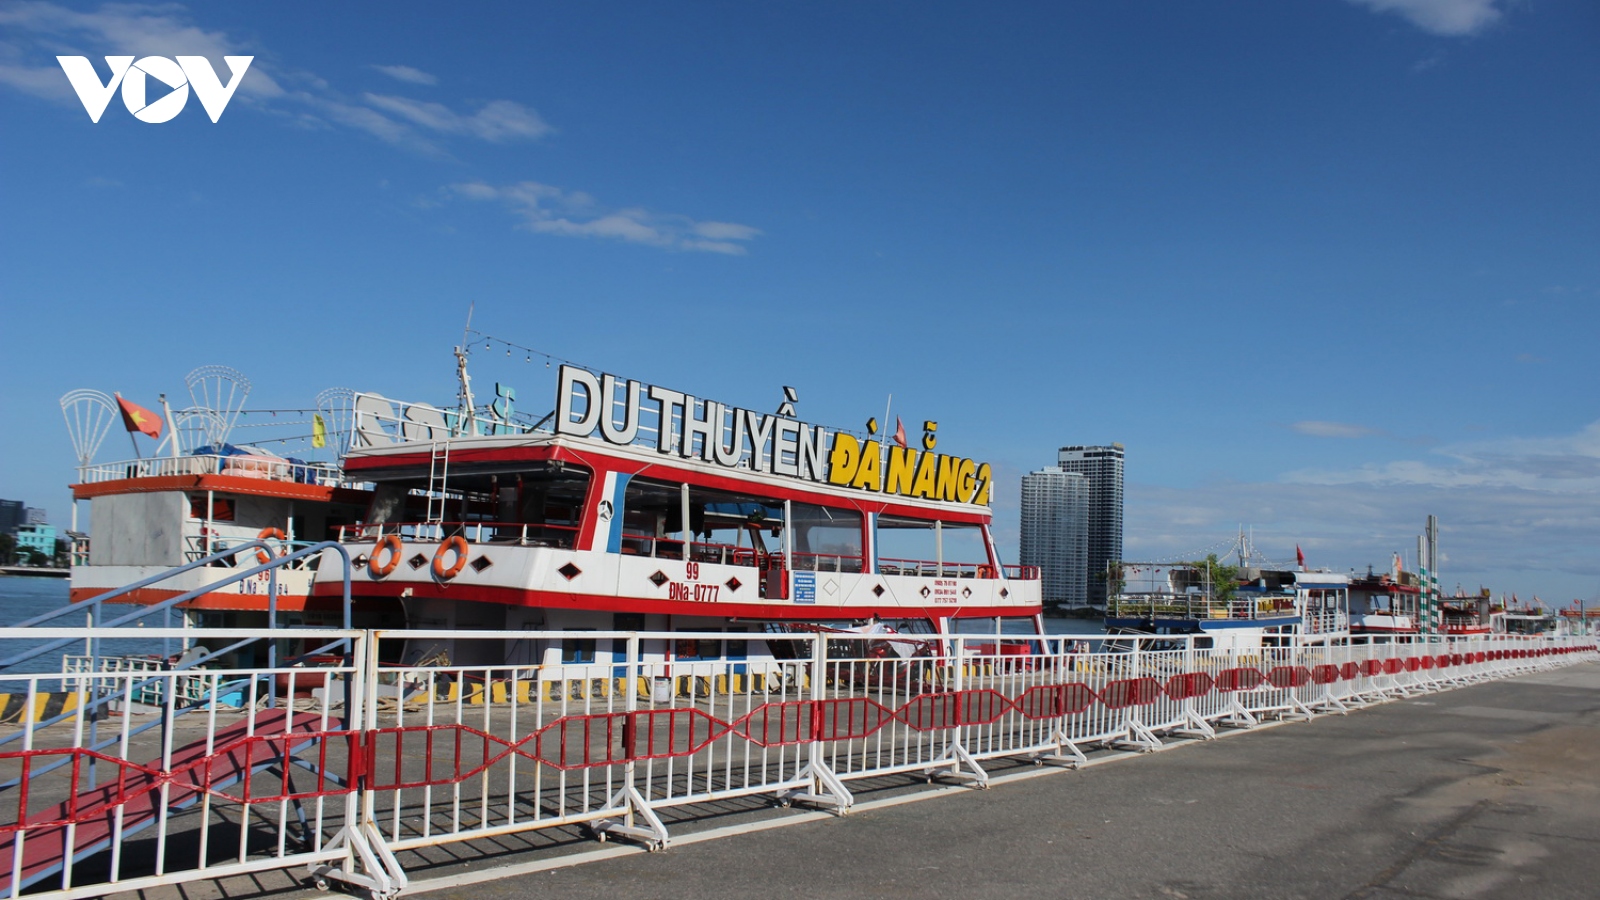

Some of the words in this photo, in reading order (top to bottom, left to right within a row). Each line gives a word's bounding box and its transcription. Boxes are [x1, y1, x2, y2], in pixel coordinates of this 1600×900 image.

[555, 363, 641, 445] DU
[647, 385, 826, 482] THUYỀN
[883, 420, 976, 504] NẴNG
[972, 461, 992, 506] 2
[686, 561, 699, 580] 99
[669, 581, 720, 603] ĐNa-0777
